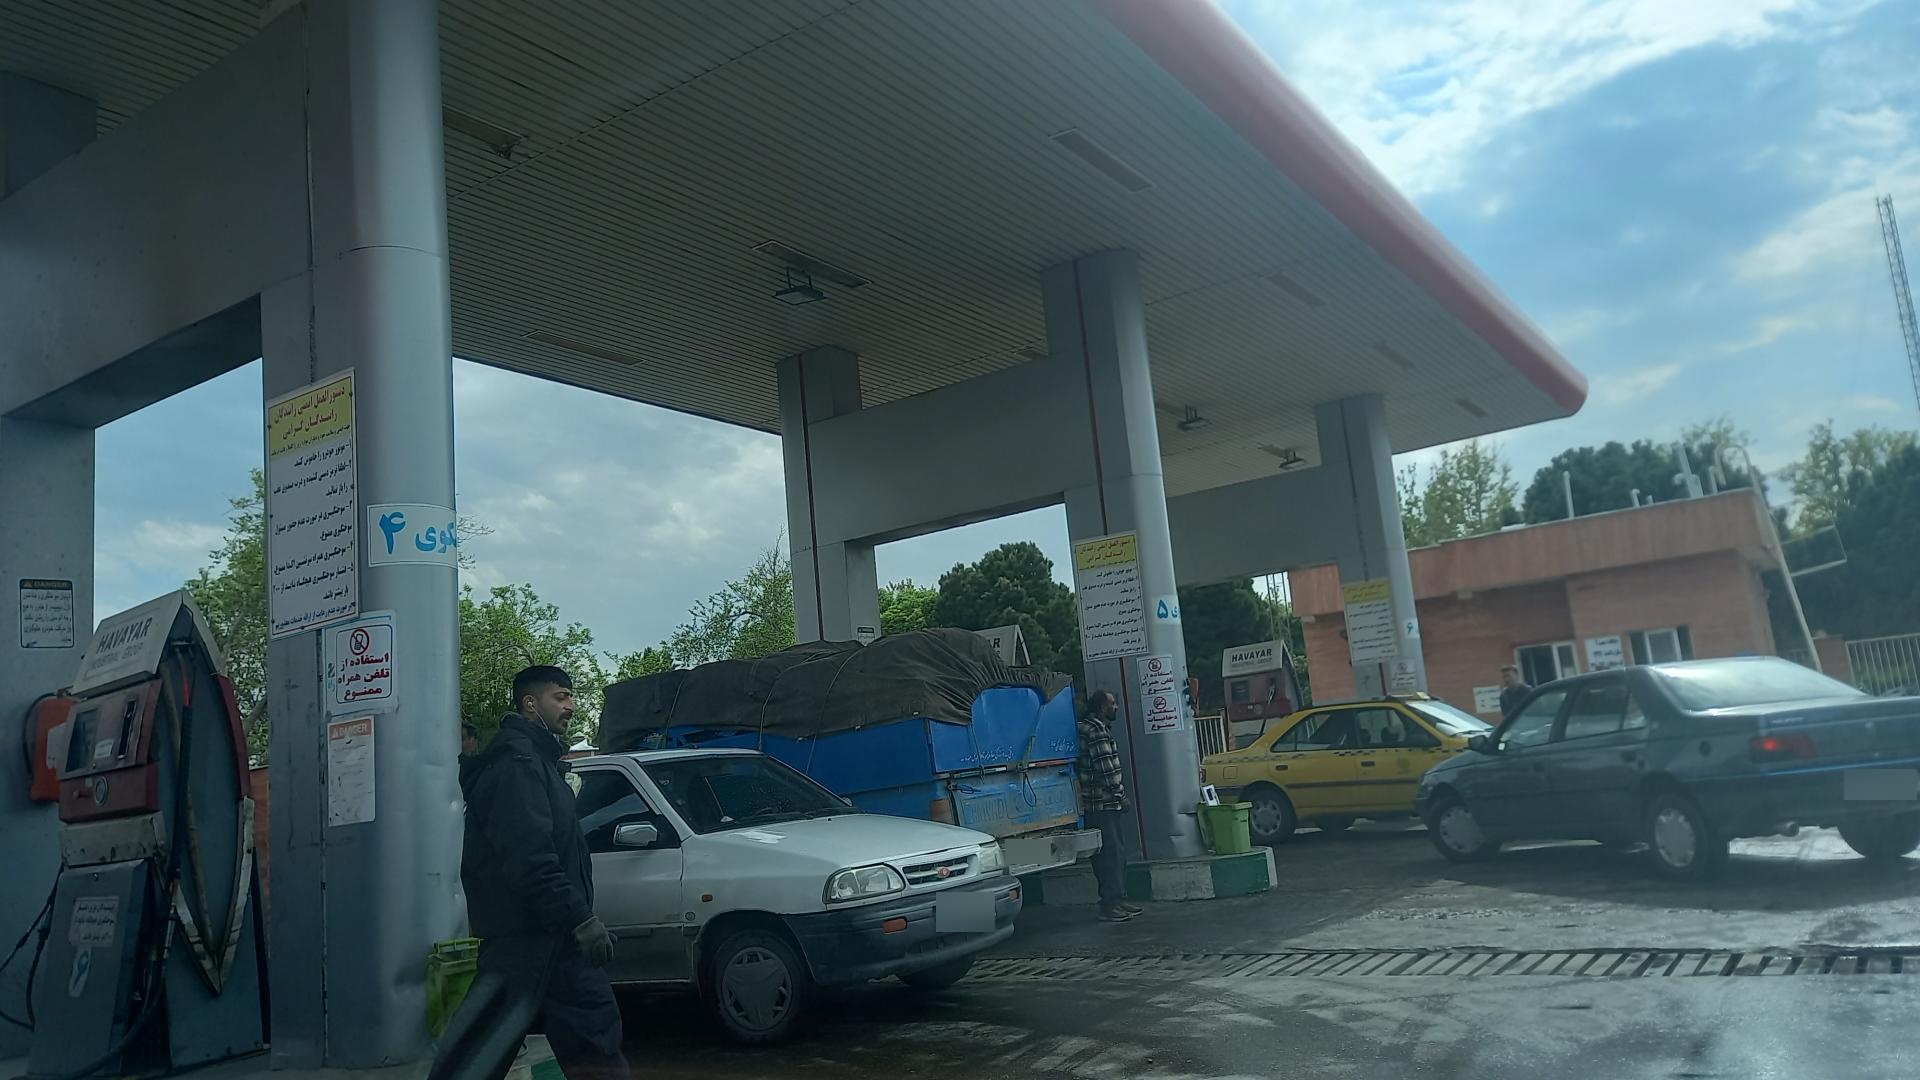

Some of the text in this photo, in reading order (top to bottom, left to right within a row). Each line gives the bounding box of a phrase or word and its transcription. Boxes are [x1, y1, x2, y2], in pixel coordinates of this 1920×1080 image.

[378, 511, 458, 555] کوی ۴
[1157, 600, 1168, 619] ۵
[96, 617, 153, 654] HAVAYAR
[340, 653, 389, 671] استفاده از
[1231, 648, 1273, 663] HAVAYAR
[338, 673, 361, 686] همراه
[364, 668, 390, 682] تلفن
[344, 687, 382, 700] ممنوع
